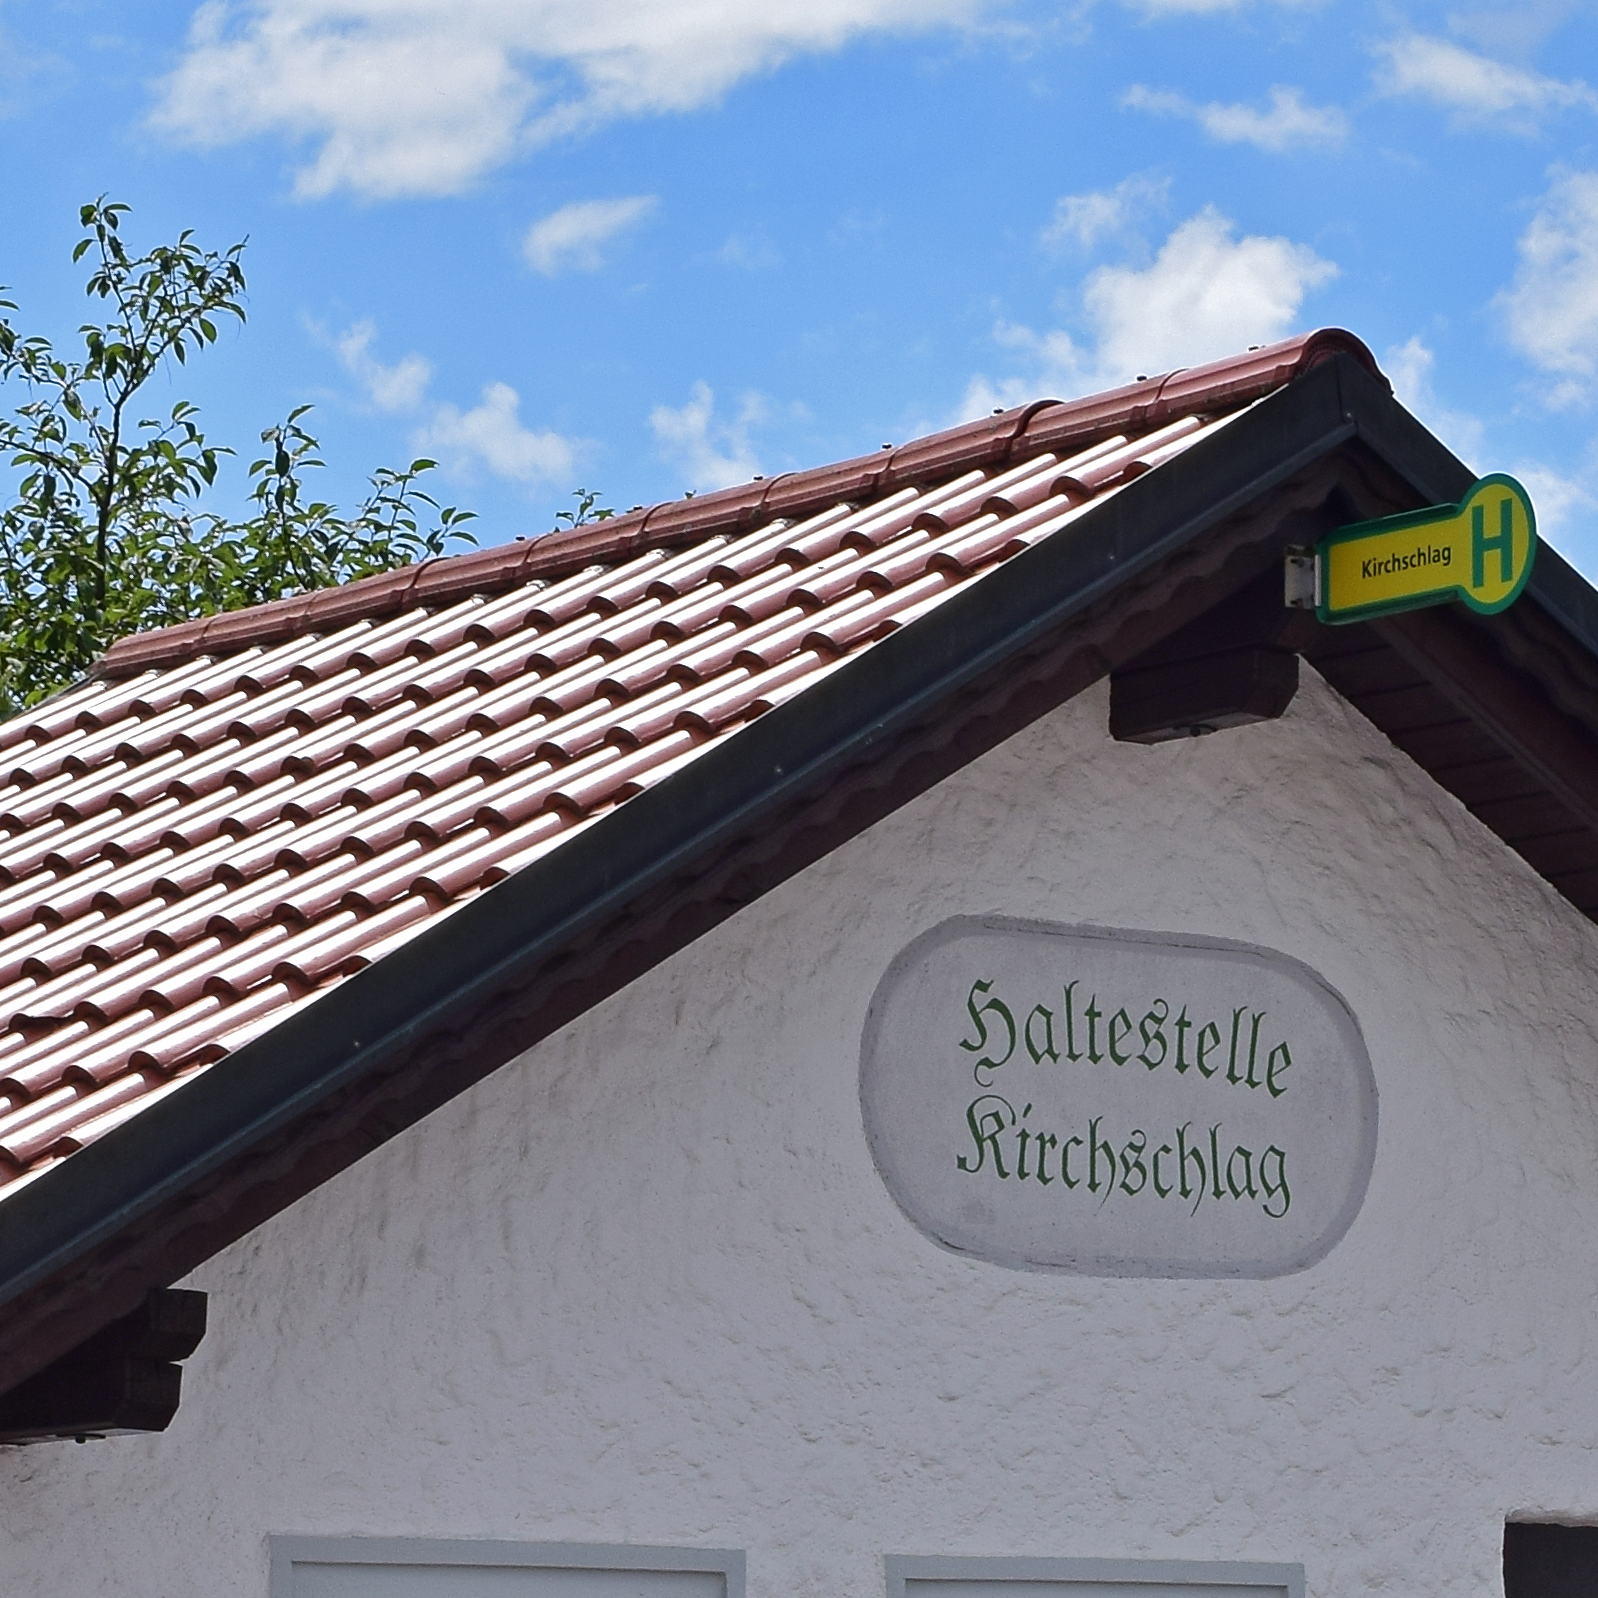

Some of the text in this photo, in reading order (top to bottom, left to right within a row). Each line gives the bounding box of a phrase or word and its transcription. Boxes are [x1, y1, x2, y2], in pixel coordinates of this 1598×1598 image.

[1361, 545, 1452, 579] Kirchschlag
[1471, 498, 1513, 589] H
[958, 978, 1292, 1099] Haltestelle
[956, 1094, 1291, 1219] Kirchschlag
